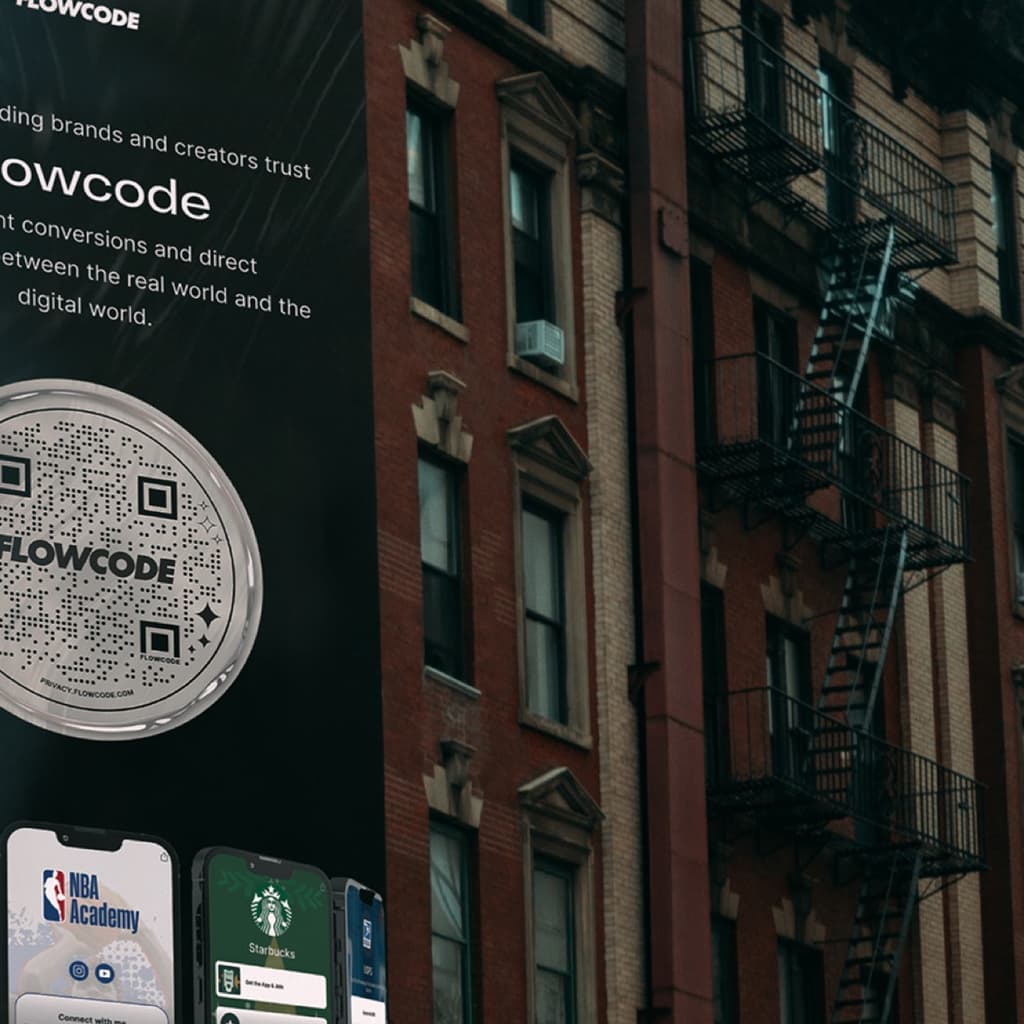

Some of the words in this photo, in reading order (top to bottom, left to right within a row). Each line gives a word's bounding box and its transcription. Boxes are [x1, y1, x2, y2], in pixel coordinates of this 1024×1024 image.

[51, 113, 124, 144] brands
[129, 133, 168, 152] and
[174, 141, 259, 170] creators
[264, 156, 311, 181] trust
[21, 219, 148, 255] conversions
[154, 243, 192, 263] and
[199, 249, 258, 275] direct
[86, 263, 121, 285] the
[127, 273, 165, 293] real
[171, 281, 227, 305] world
[234, 293, 272, 312] and
[278, 298, 311, 319] the
[17, 287, 82, 314] digital
[88, 302, 152, 327] world.
[139, 654, 181, 665] FLOWCODE
[40, 678, 134, 698] PRIVACY.FLOWCODE.COM
[69, 871, 99, 900] NBA
[70, 899, 140, 934] Academy
[248, 942, 296, 960] Starbucks
[261, 980, 271, 989] App
[58, 1013, 93, 1024] Connect
